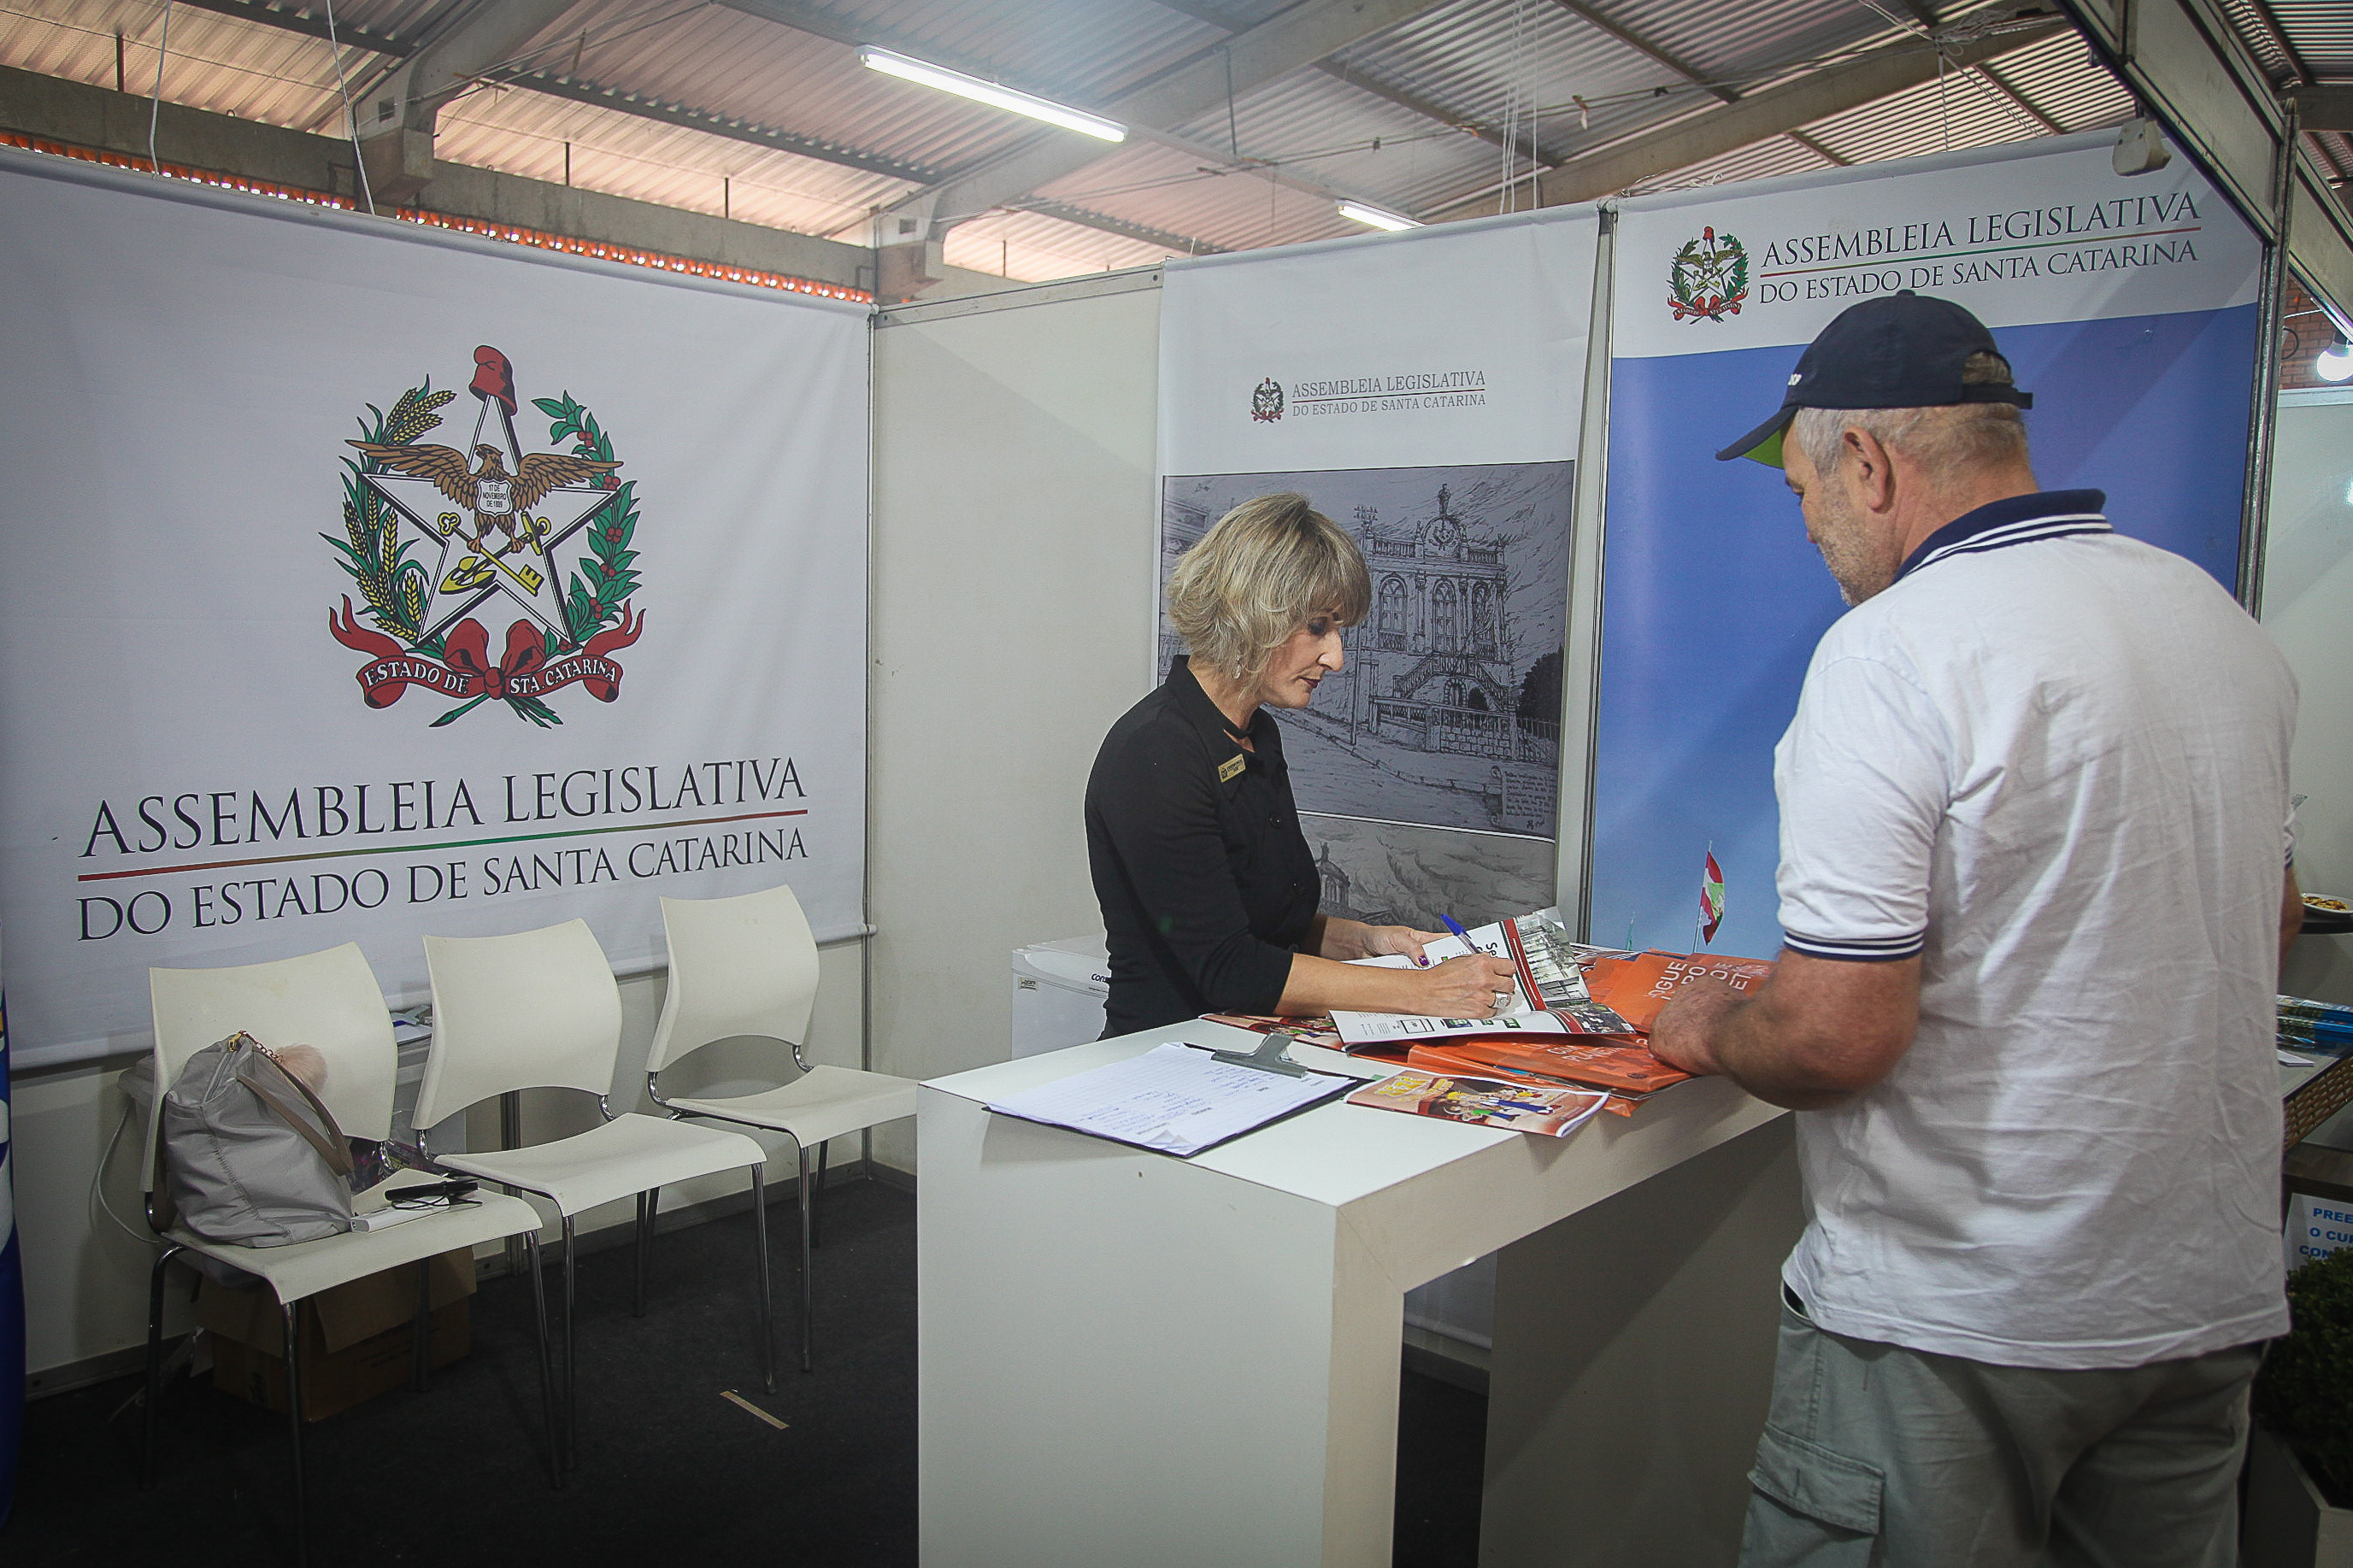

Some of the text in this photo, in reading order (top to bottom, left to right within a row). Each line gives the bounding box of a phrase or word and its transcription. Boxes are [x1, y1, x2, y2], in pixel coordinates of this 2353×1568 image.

[1761, 191, 2201, 268] ASSEMBLEIA LEGISLATIVA
[1759, 239, 2199, 305] DO ESTADO DE SANTA CATARINA
[1291, 370, 1486, 398] ASSEMBLEIA LEGISLATIVA
[1292, 394, 1486, 416] DO ESTADO DE SANTA CATARINA
[364, 661, 440, 687] ESTADO
[443, 673, 469, 694] DE
[80, 756, 809, 858] ASSEMBLEIA LEGISLATIVA
[76, 827, 809, 942] DO ESTADO DE SANTA CATARINA
[2309, 1227, 2321, 1237] O
